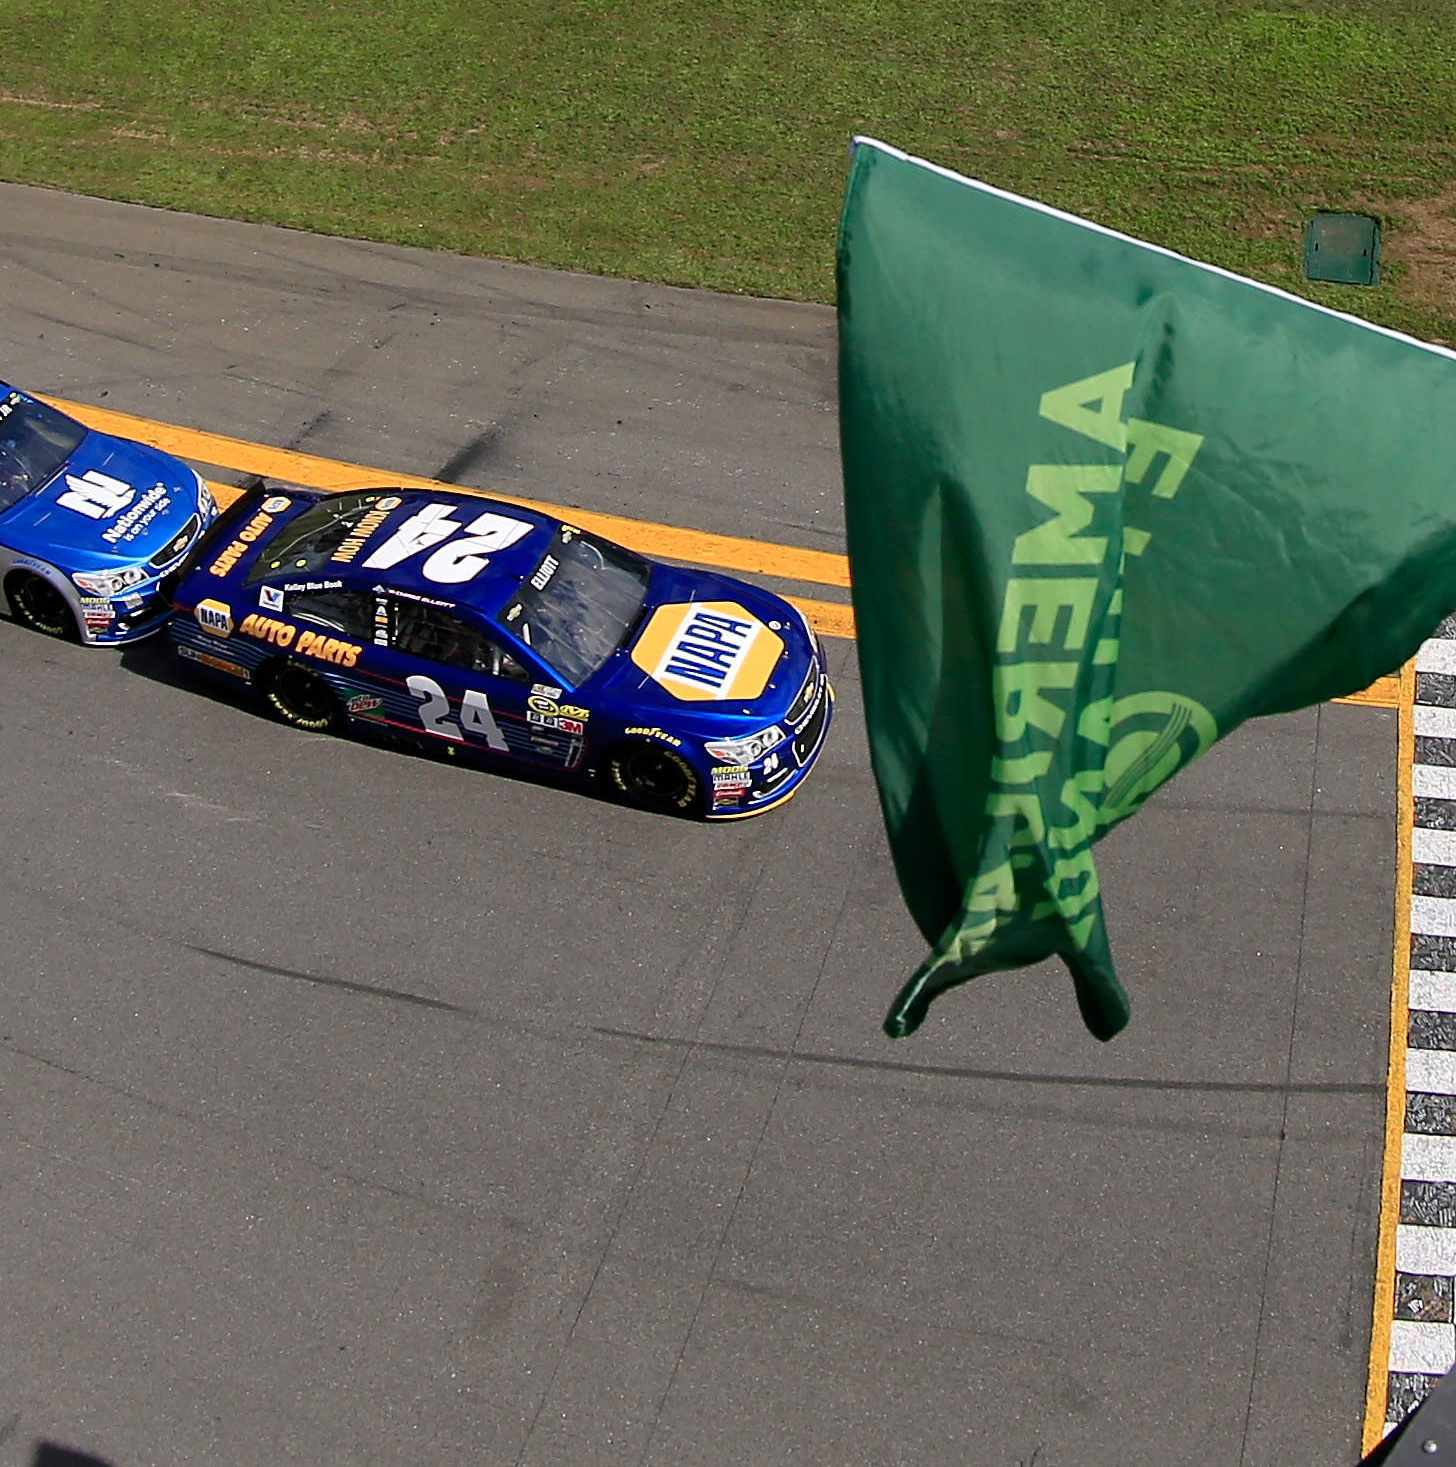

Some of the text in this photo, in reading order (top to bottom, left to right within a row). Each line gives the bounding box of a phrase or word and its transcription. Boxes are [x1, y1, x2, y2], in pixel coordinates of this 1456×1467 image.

[101, 481, 169, 545] Nationwide
[122, 529, 133, 543] is
[132, 519, 145, 535] on
[153, 495, 172, 518] side
[330, 510, 391, 564] KNOW HOW
[208, 511, 274, 579] AUTO PARTS
[361, 502, 536, 584] 24
[284, 579, 343, 593] Kelley Blue Book
[529, 553, 560, 592] ELLIOTT
[200, 607, 229, 632] NAPA
[238, 613, 297, 648] AUTO
[294, 630, 364, 668] PARTS
[663, 610, 754, 690] NAPA
[405, 674, 511, 752] 24
[558, 718, 583, 734] 3M
[625, 727, 682, 747] GOODYEAR
[711, 765, 749, 774] MOOG
[762, 752, 780, 775] 24
